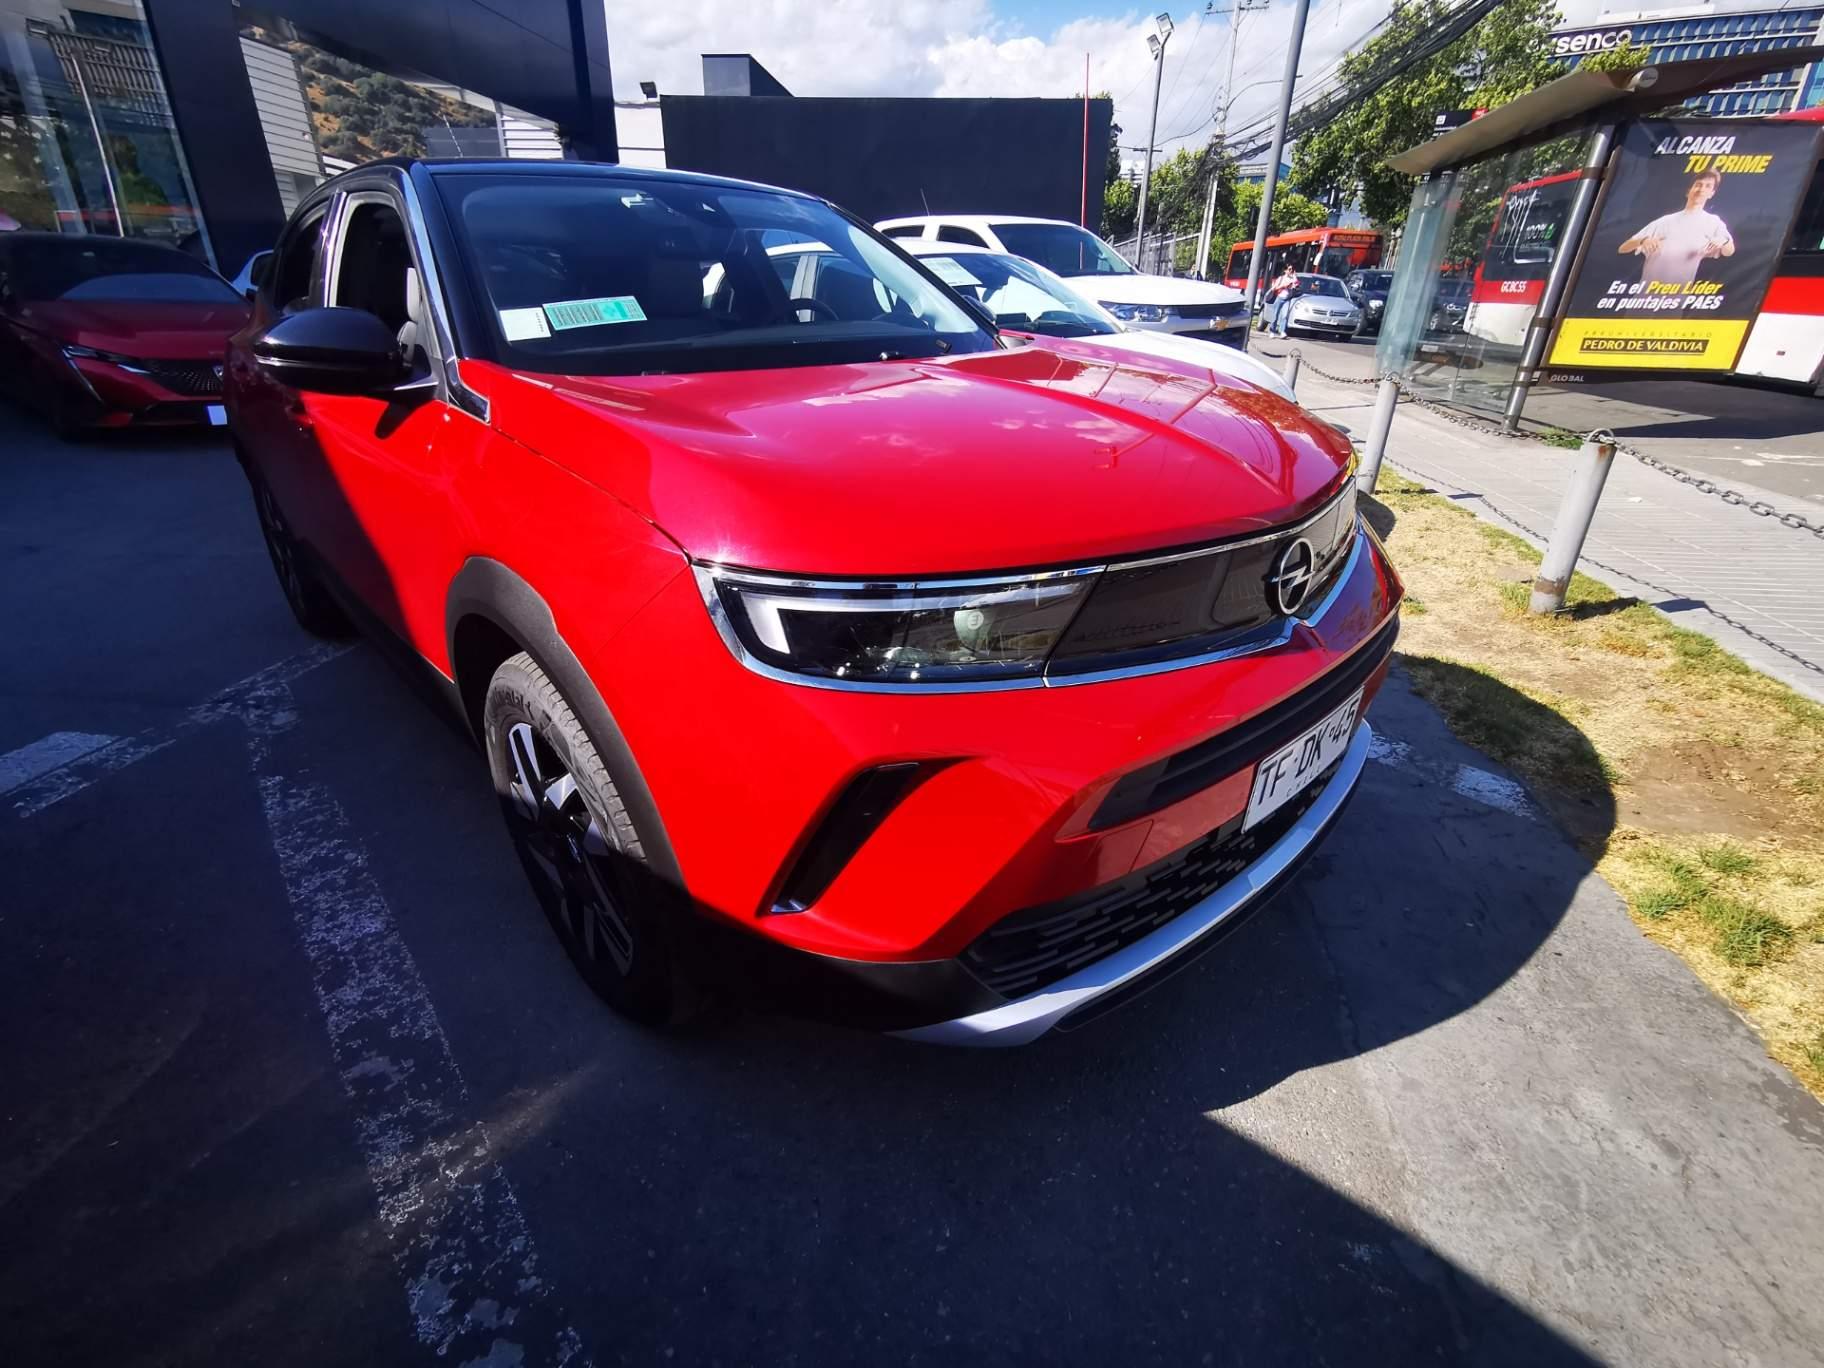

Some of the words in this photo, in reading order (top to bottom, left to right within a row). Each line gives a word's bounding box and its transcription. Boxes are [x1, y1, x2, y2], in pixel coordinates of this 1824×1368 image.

[1654, 136, 1736, 154] ALCANZA
[1684, 155, 1713, 173] TU
[1712, 155, 1772, 173] PRIME
[1607, 280, 1627, 295] En
[1629, 281, 1646, 295] el
[1646, 281, 1681, 295] Preu
[1681, 280, 1723, 295] Líder
[1597, 297, 1616, 309] en
[1615, 296, 1681, 312] puntajes
[1682, 295, 1723, 310] PAES
[1583, 340, 1625, 351] PEDRO
[1627, 340, 1646, 351] DE
[1646, 341, 1703, 351] VALDIVIA
